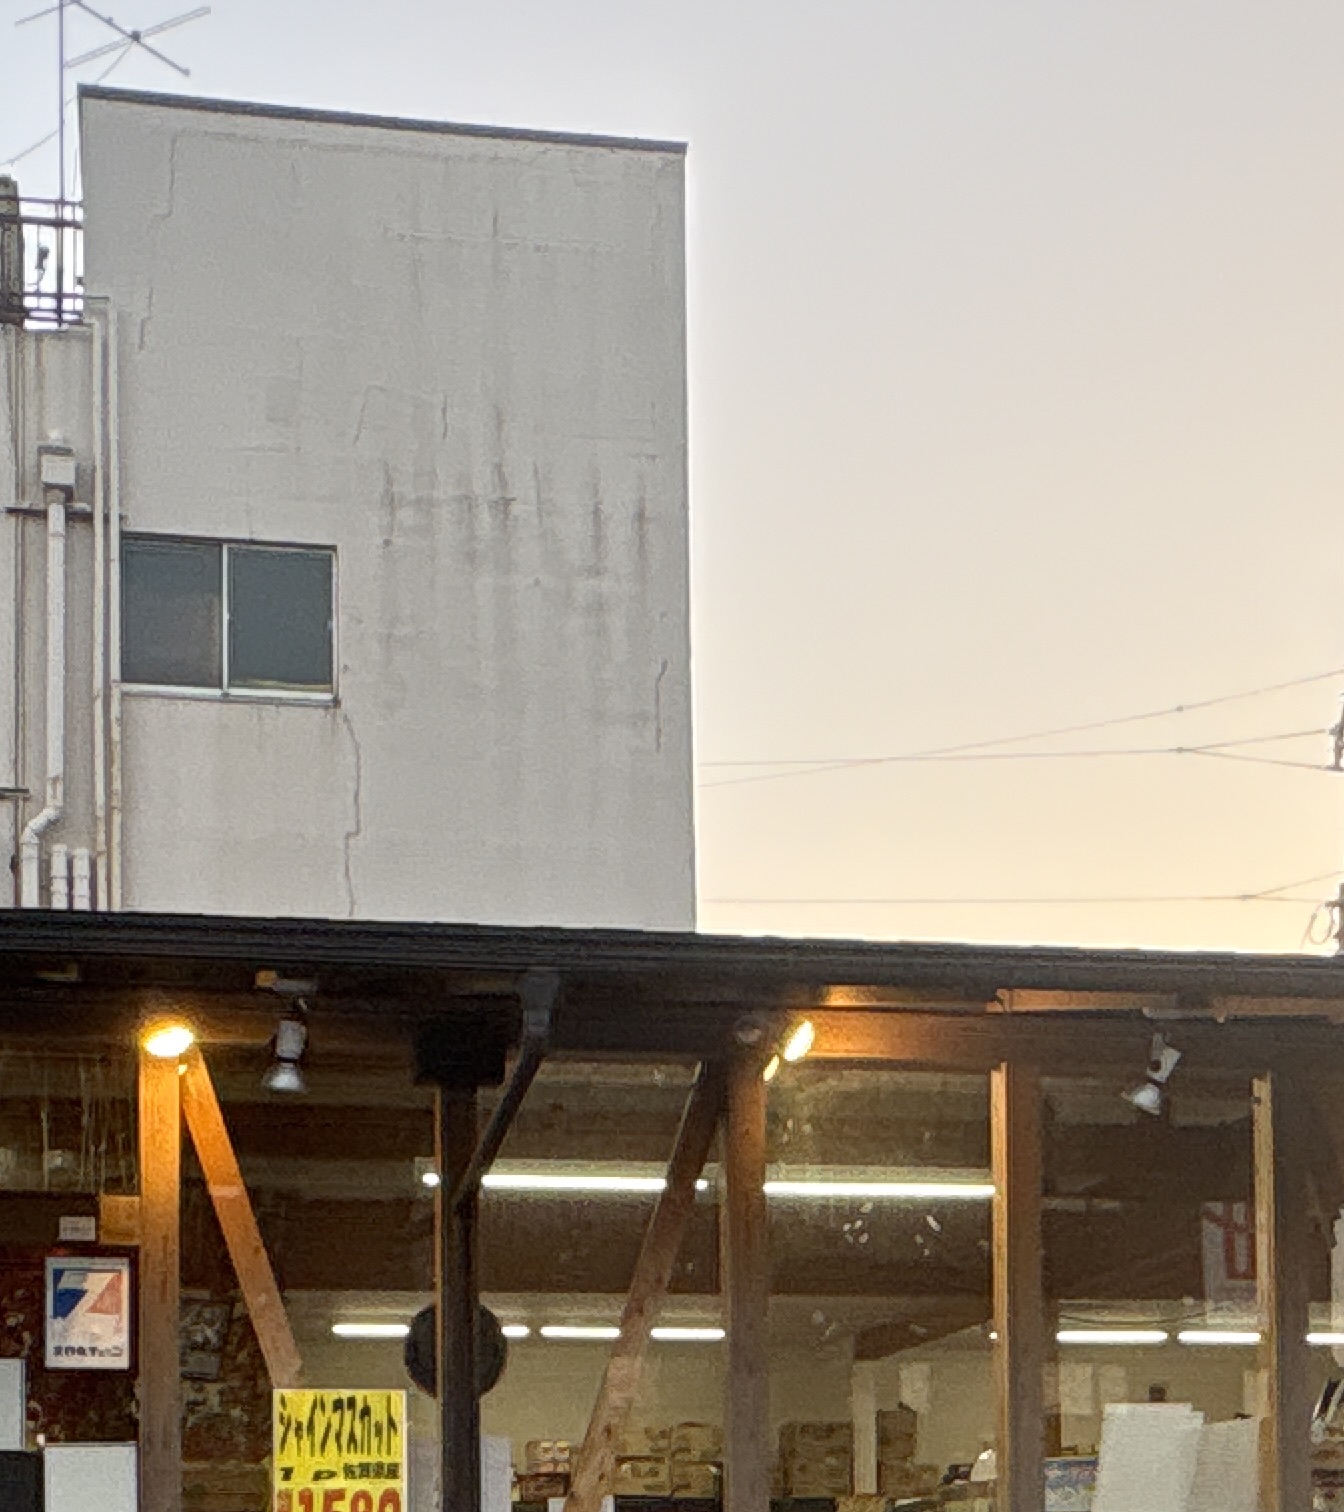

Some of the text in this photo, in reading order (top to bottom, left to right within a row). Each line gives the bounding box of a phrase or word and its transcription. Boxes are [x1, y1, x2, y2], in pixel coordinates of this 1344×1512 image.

[279, 1394, 398, 1457] シャインマスカット
